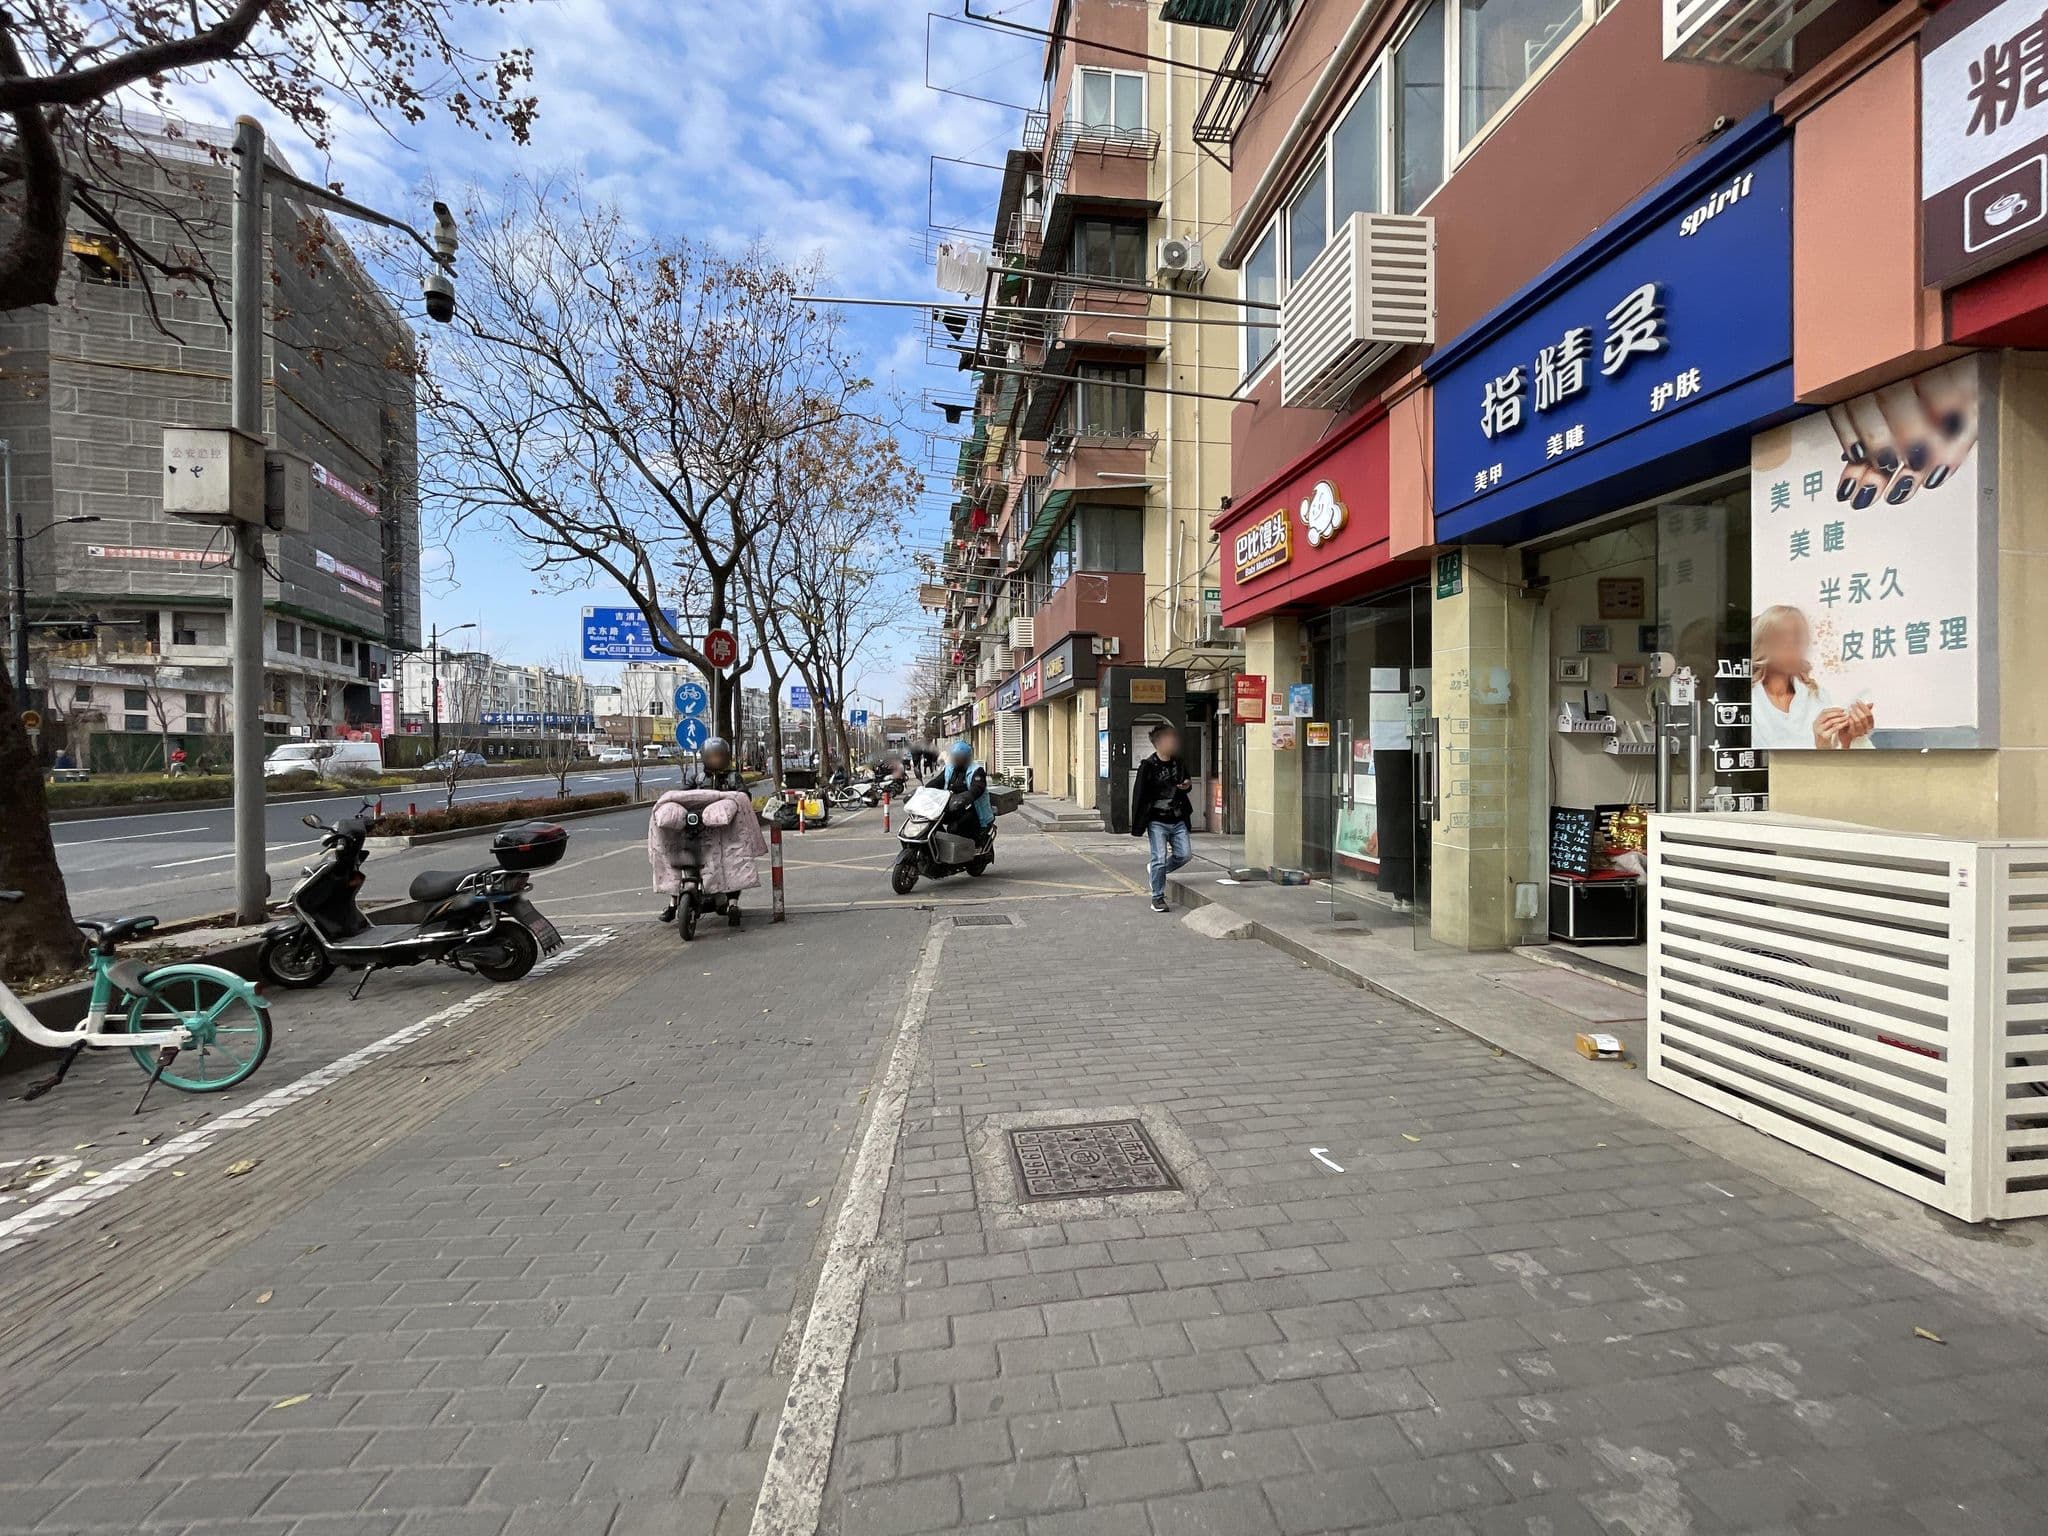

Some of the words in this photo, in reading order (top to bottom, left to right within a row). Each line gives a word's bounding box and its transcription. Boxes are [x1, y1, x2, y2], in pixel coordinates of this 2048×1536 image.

[1678, 172, 1753, 236] spirit
[1480, 282, 1664, 439] 指精灵
[1474, 463, 1503, 493] 美甲
[1546, 424, 1585, 460] 美睫
[1650, 367, 1701, 412] 护肤
[1770, 470, 1824, 513] 美甲
[1236, 514, 1286, 566] 巴比馒头
[1789, 520, 1845, 560] 美睫
[1818, 566, 1905, 608] 半永久
[587, 626, 619, 636] 武东路
[711, 638, 731, 661] 停
[1841, 616, 1968, 663] 皮肤管理
[855, 711, 862, 721] P
[1021, 1147, 1047, 1175] 1996
